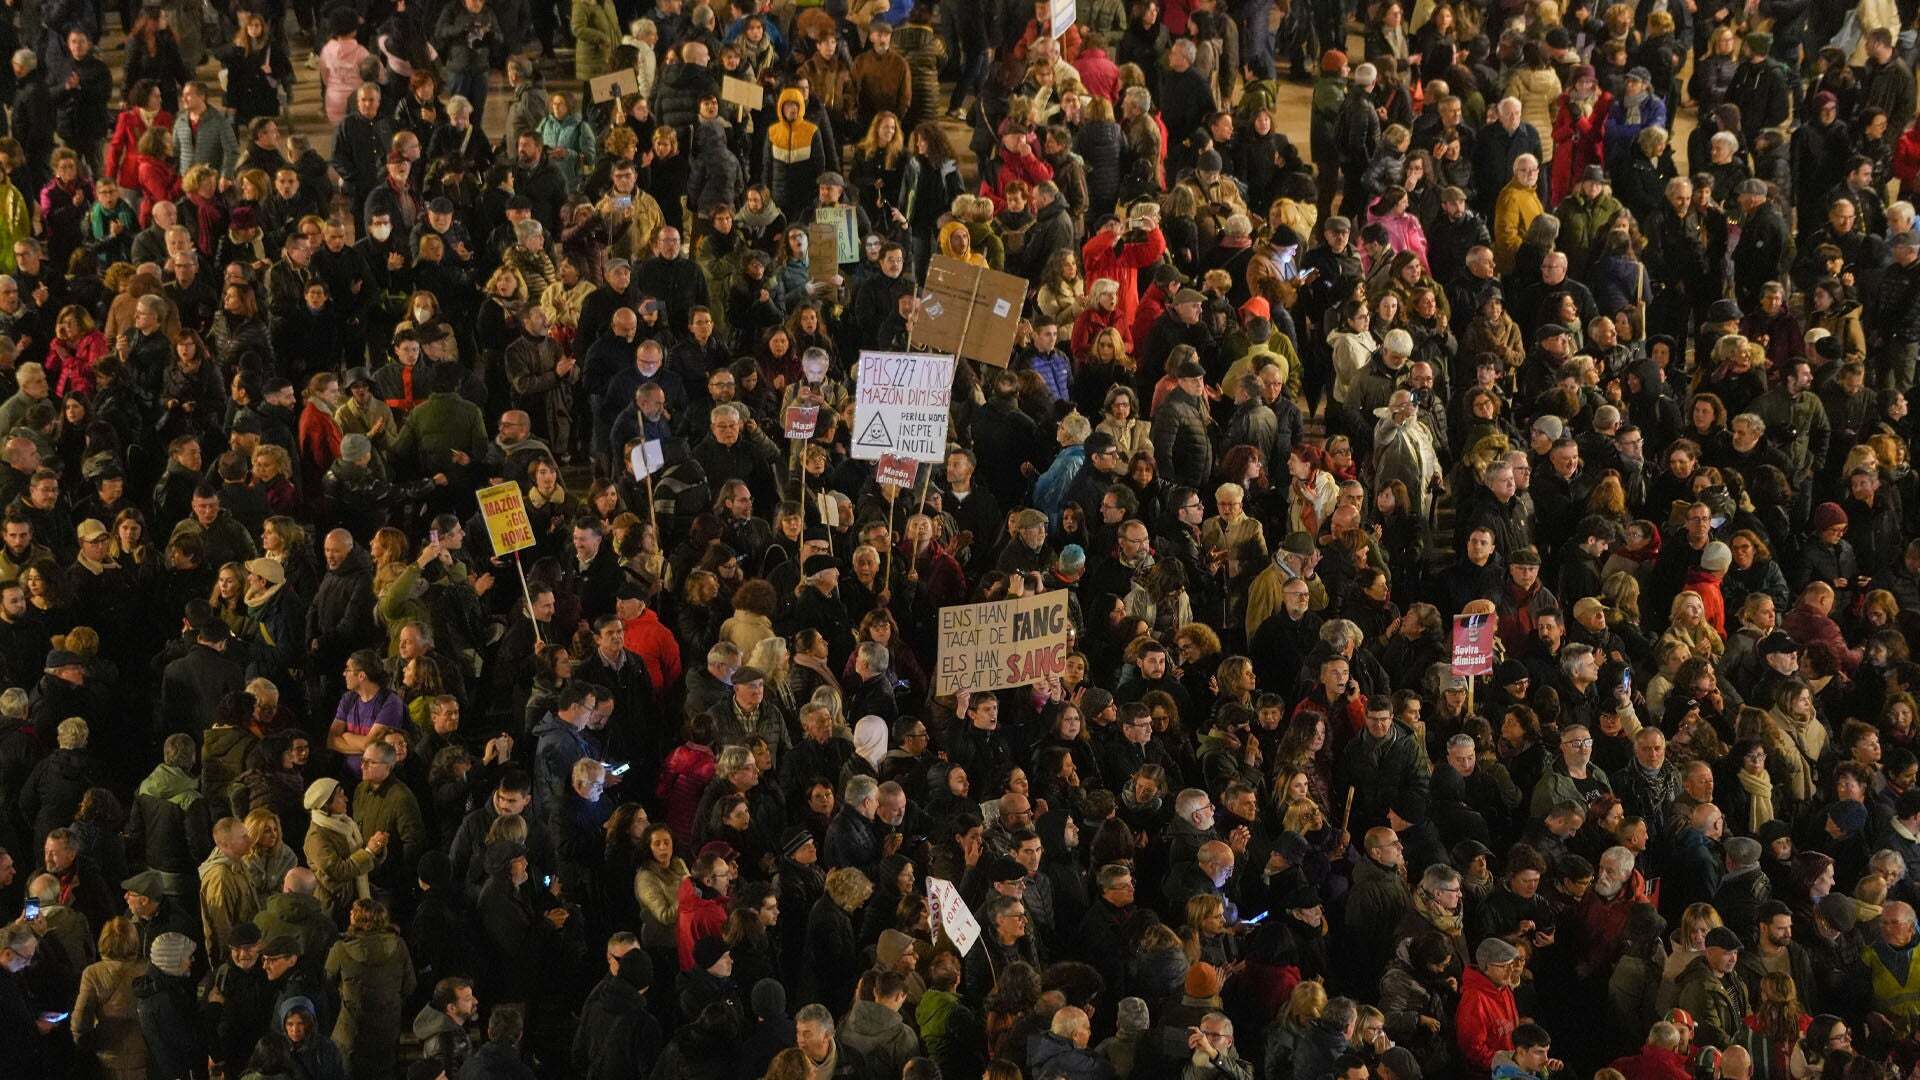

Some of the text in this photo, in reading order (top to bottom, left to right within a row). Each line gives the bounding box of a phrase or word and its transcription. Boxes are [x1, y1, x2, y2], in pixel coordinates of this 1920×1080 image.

[892, 359, 917, 387] 227
[878, 475, 911, 487] dimissió
[883, 466, 909, 479] Mazón
[485, 495, 519, 517] MAZÓN
[500, 526, 532, 547] HOME
[943, 603, 1008, 629] ENS HAN
[943, 604, 1064, 649] TACAT DE FANG
[941, 643, 1066, 692] TACAT DE SANG
[942, 650, 999, 674] ELS HAN
